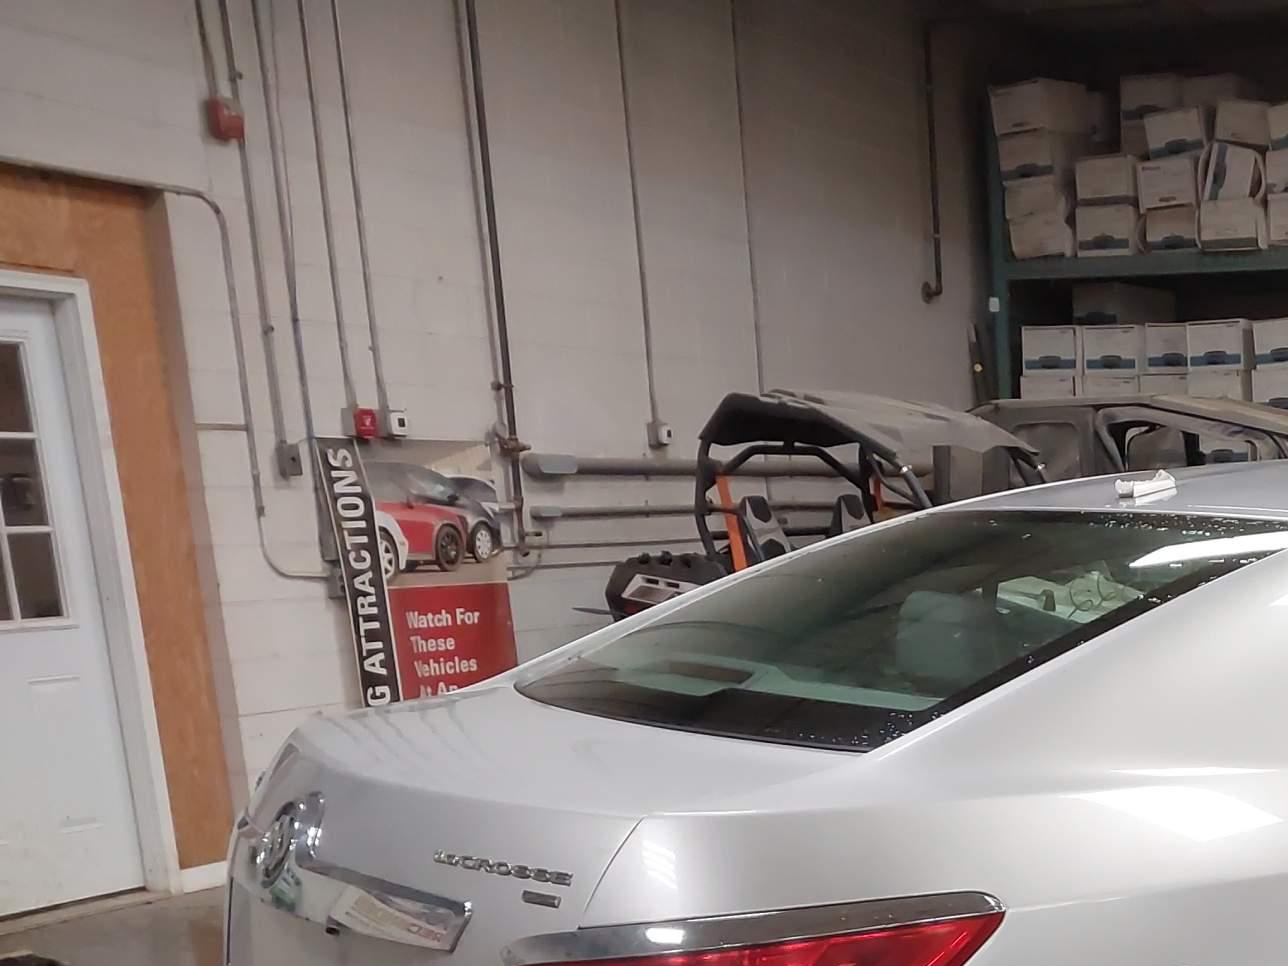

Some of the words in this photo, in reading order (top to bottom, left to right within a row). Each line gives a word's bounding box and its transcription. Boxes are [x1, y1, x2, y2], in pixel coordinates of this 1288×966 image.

[327, 448, 387, 675] ATTRACTIONS
[405, 609, 452, 629] Watch
[455, 608, 480, 625] For
[410, 635, 455, 653] These
[414, 656, 478, 678] Vehicles
[434, 849, 573, 886] LACROSSE
